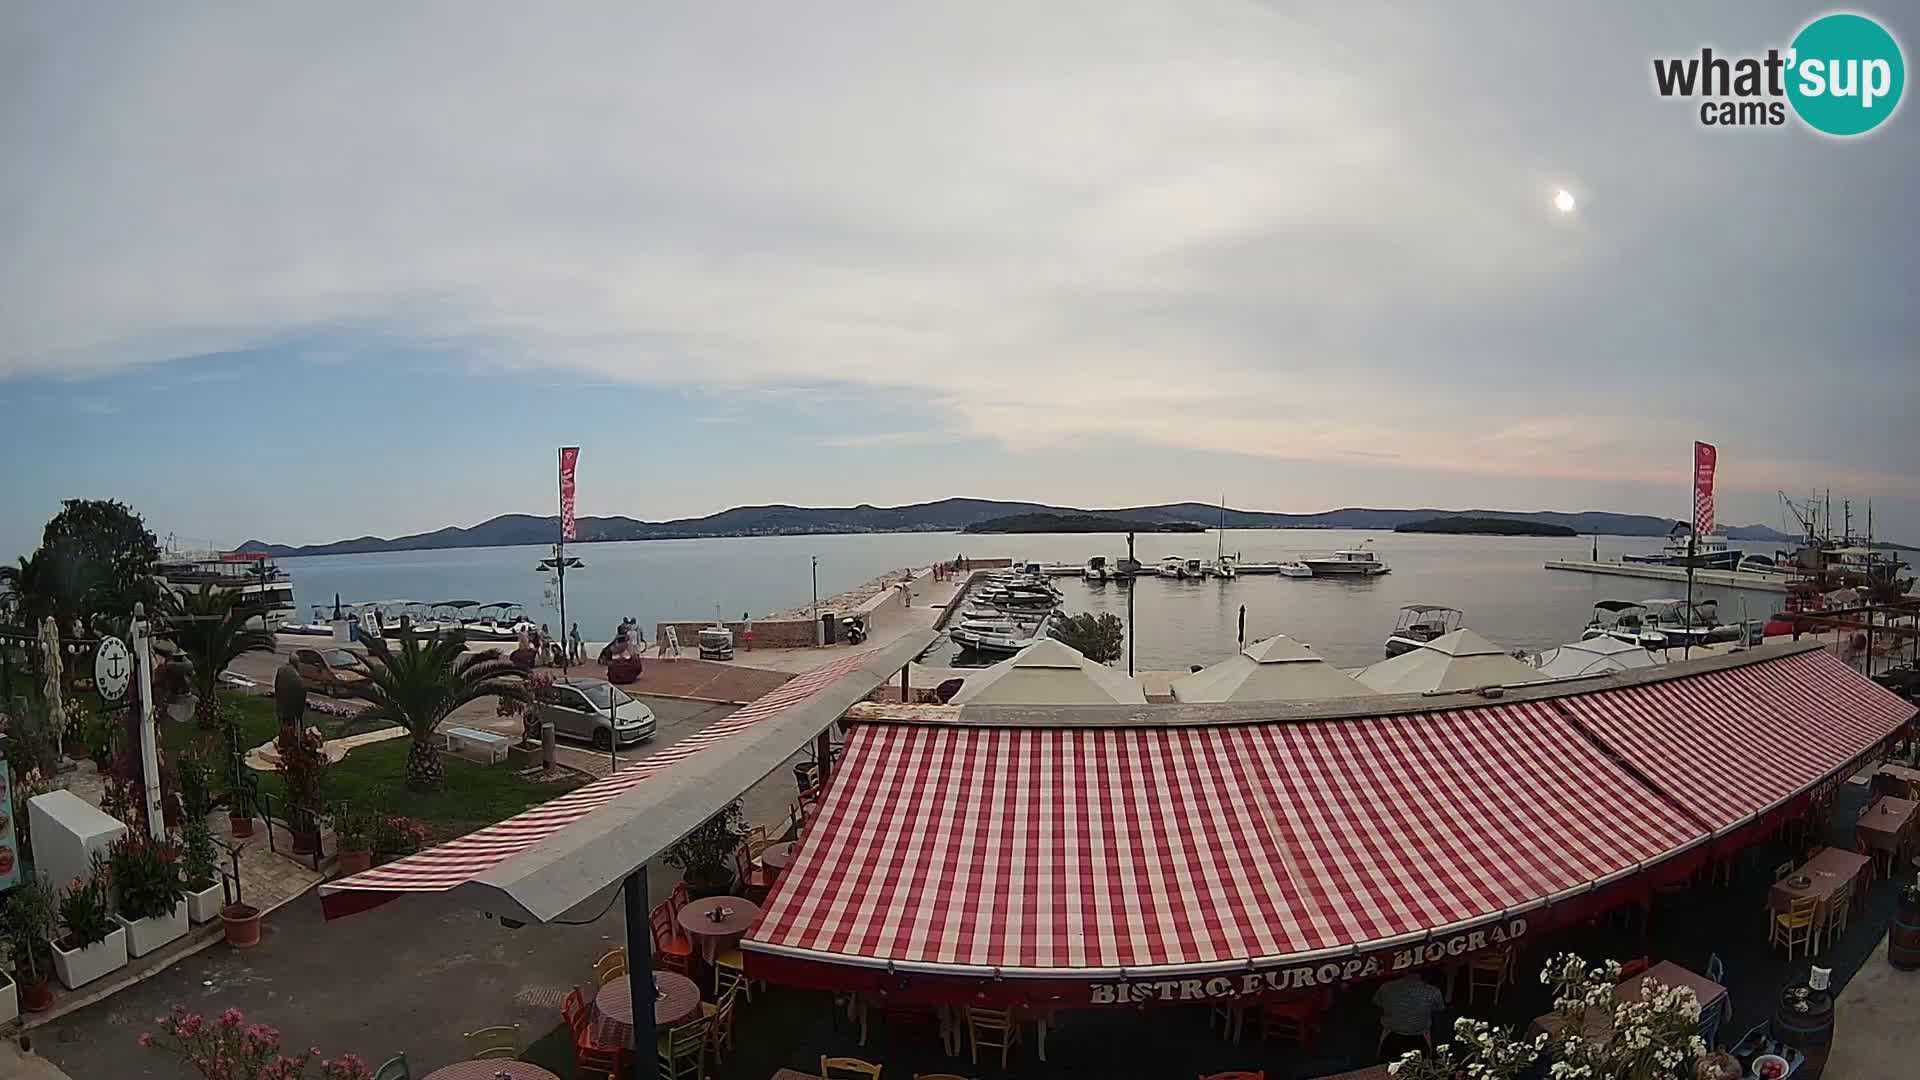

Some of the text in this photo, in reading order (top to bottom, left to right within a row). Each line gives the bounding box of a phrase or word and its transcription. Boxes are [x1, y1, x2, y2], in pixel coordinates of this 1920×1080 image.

[1089, 918, 1528, 1004] BISTRO EUROPA BIOGRAD
